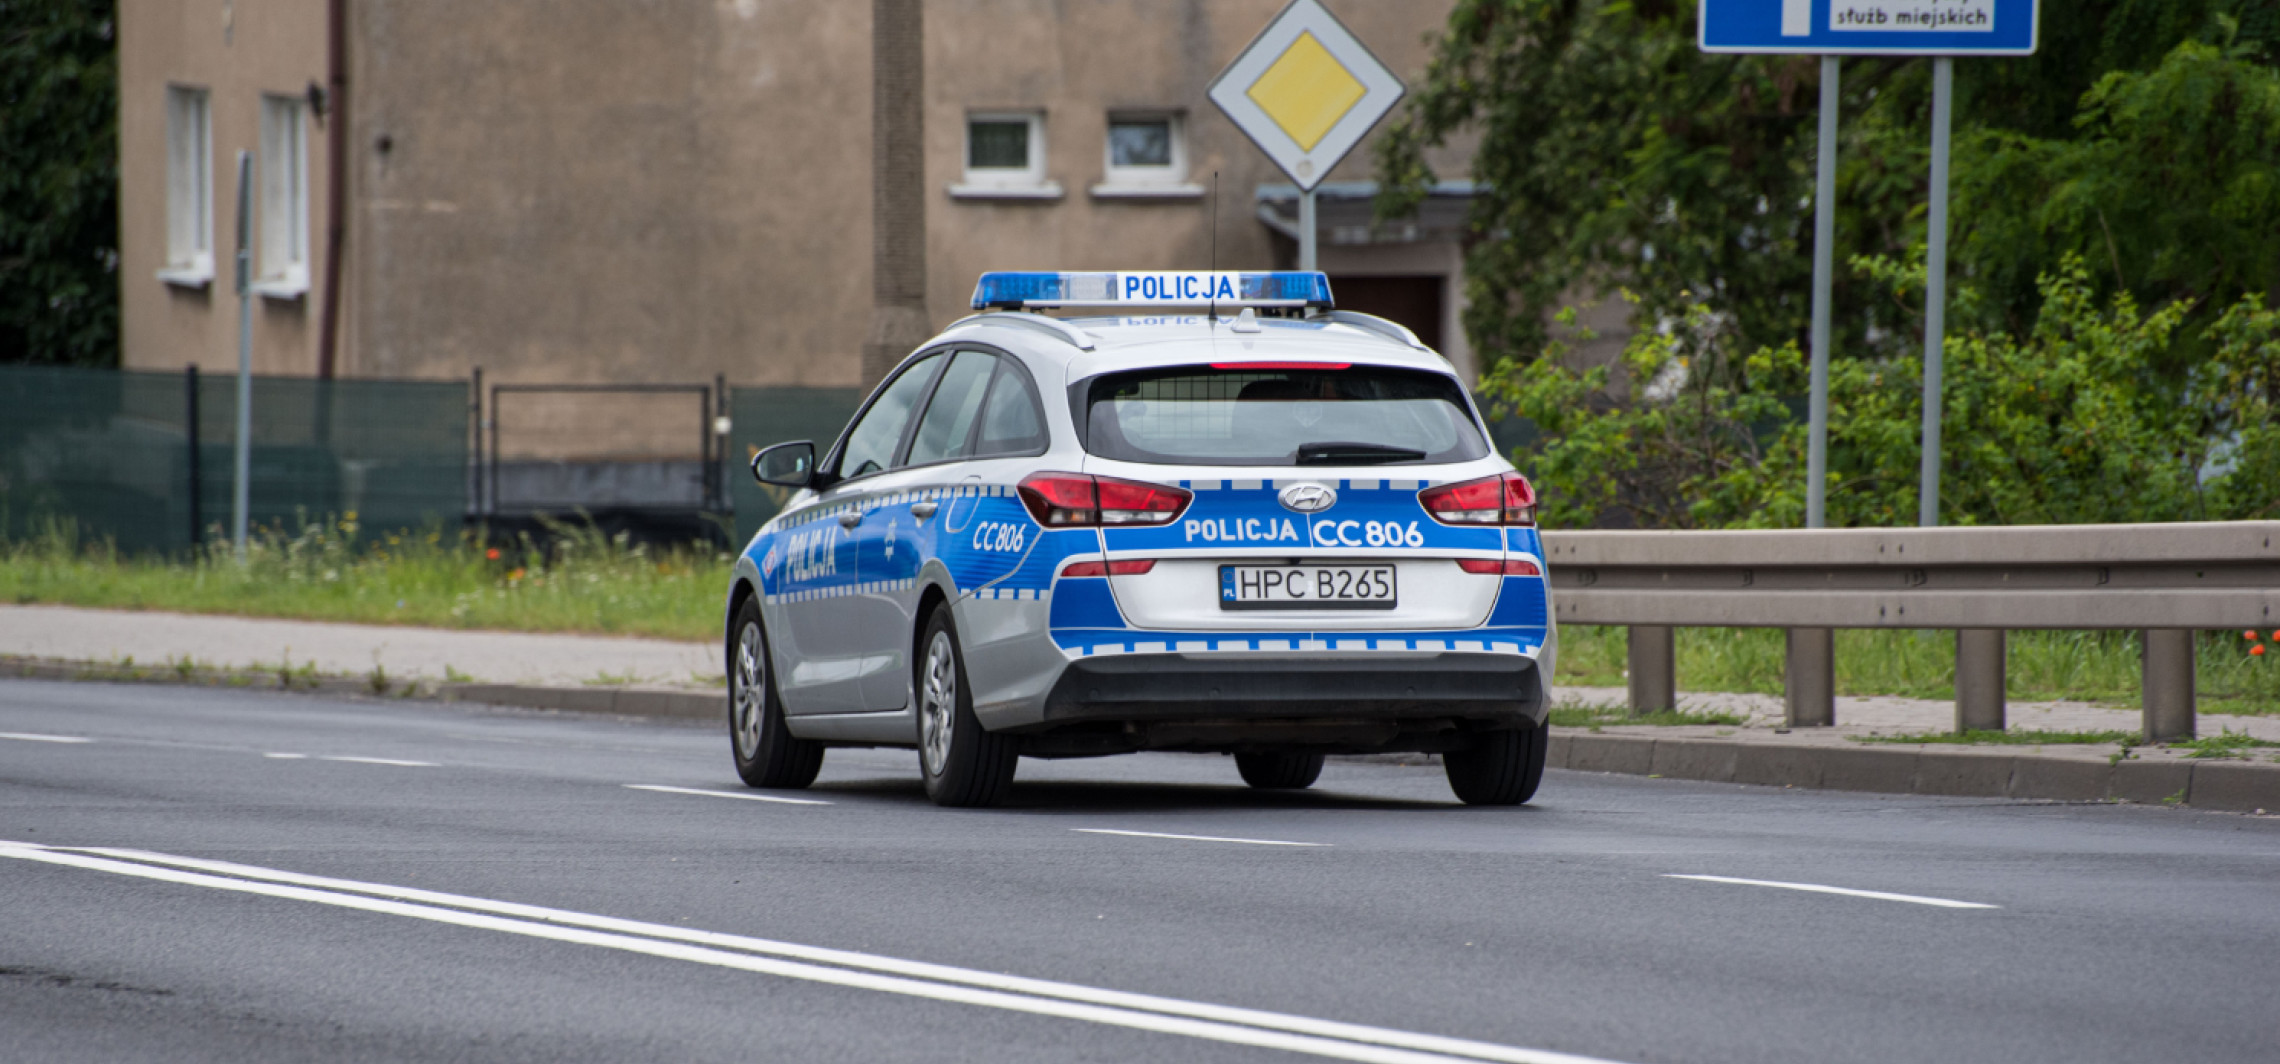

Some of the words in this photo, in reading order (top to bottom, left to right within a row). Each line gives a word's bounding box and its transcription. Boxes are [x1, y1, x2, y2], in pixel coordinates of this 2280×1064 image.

[1838, 8, 1887, 25] służb
[1896, 8, 1987, 29] miejskich
[1125, 275, 1235, 299] POLICJA
[1184, 518, 1299, 542] POLICJA
[785, 525, 838, 585] POLICJA
[1223, 588, 1235, 597] PL
[1240, 569, 1306, 599] HPC
[1316, 569, 1390, 599] B265
